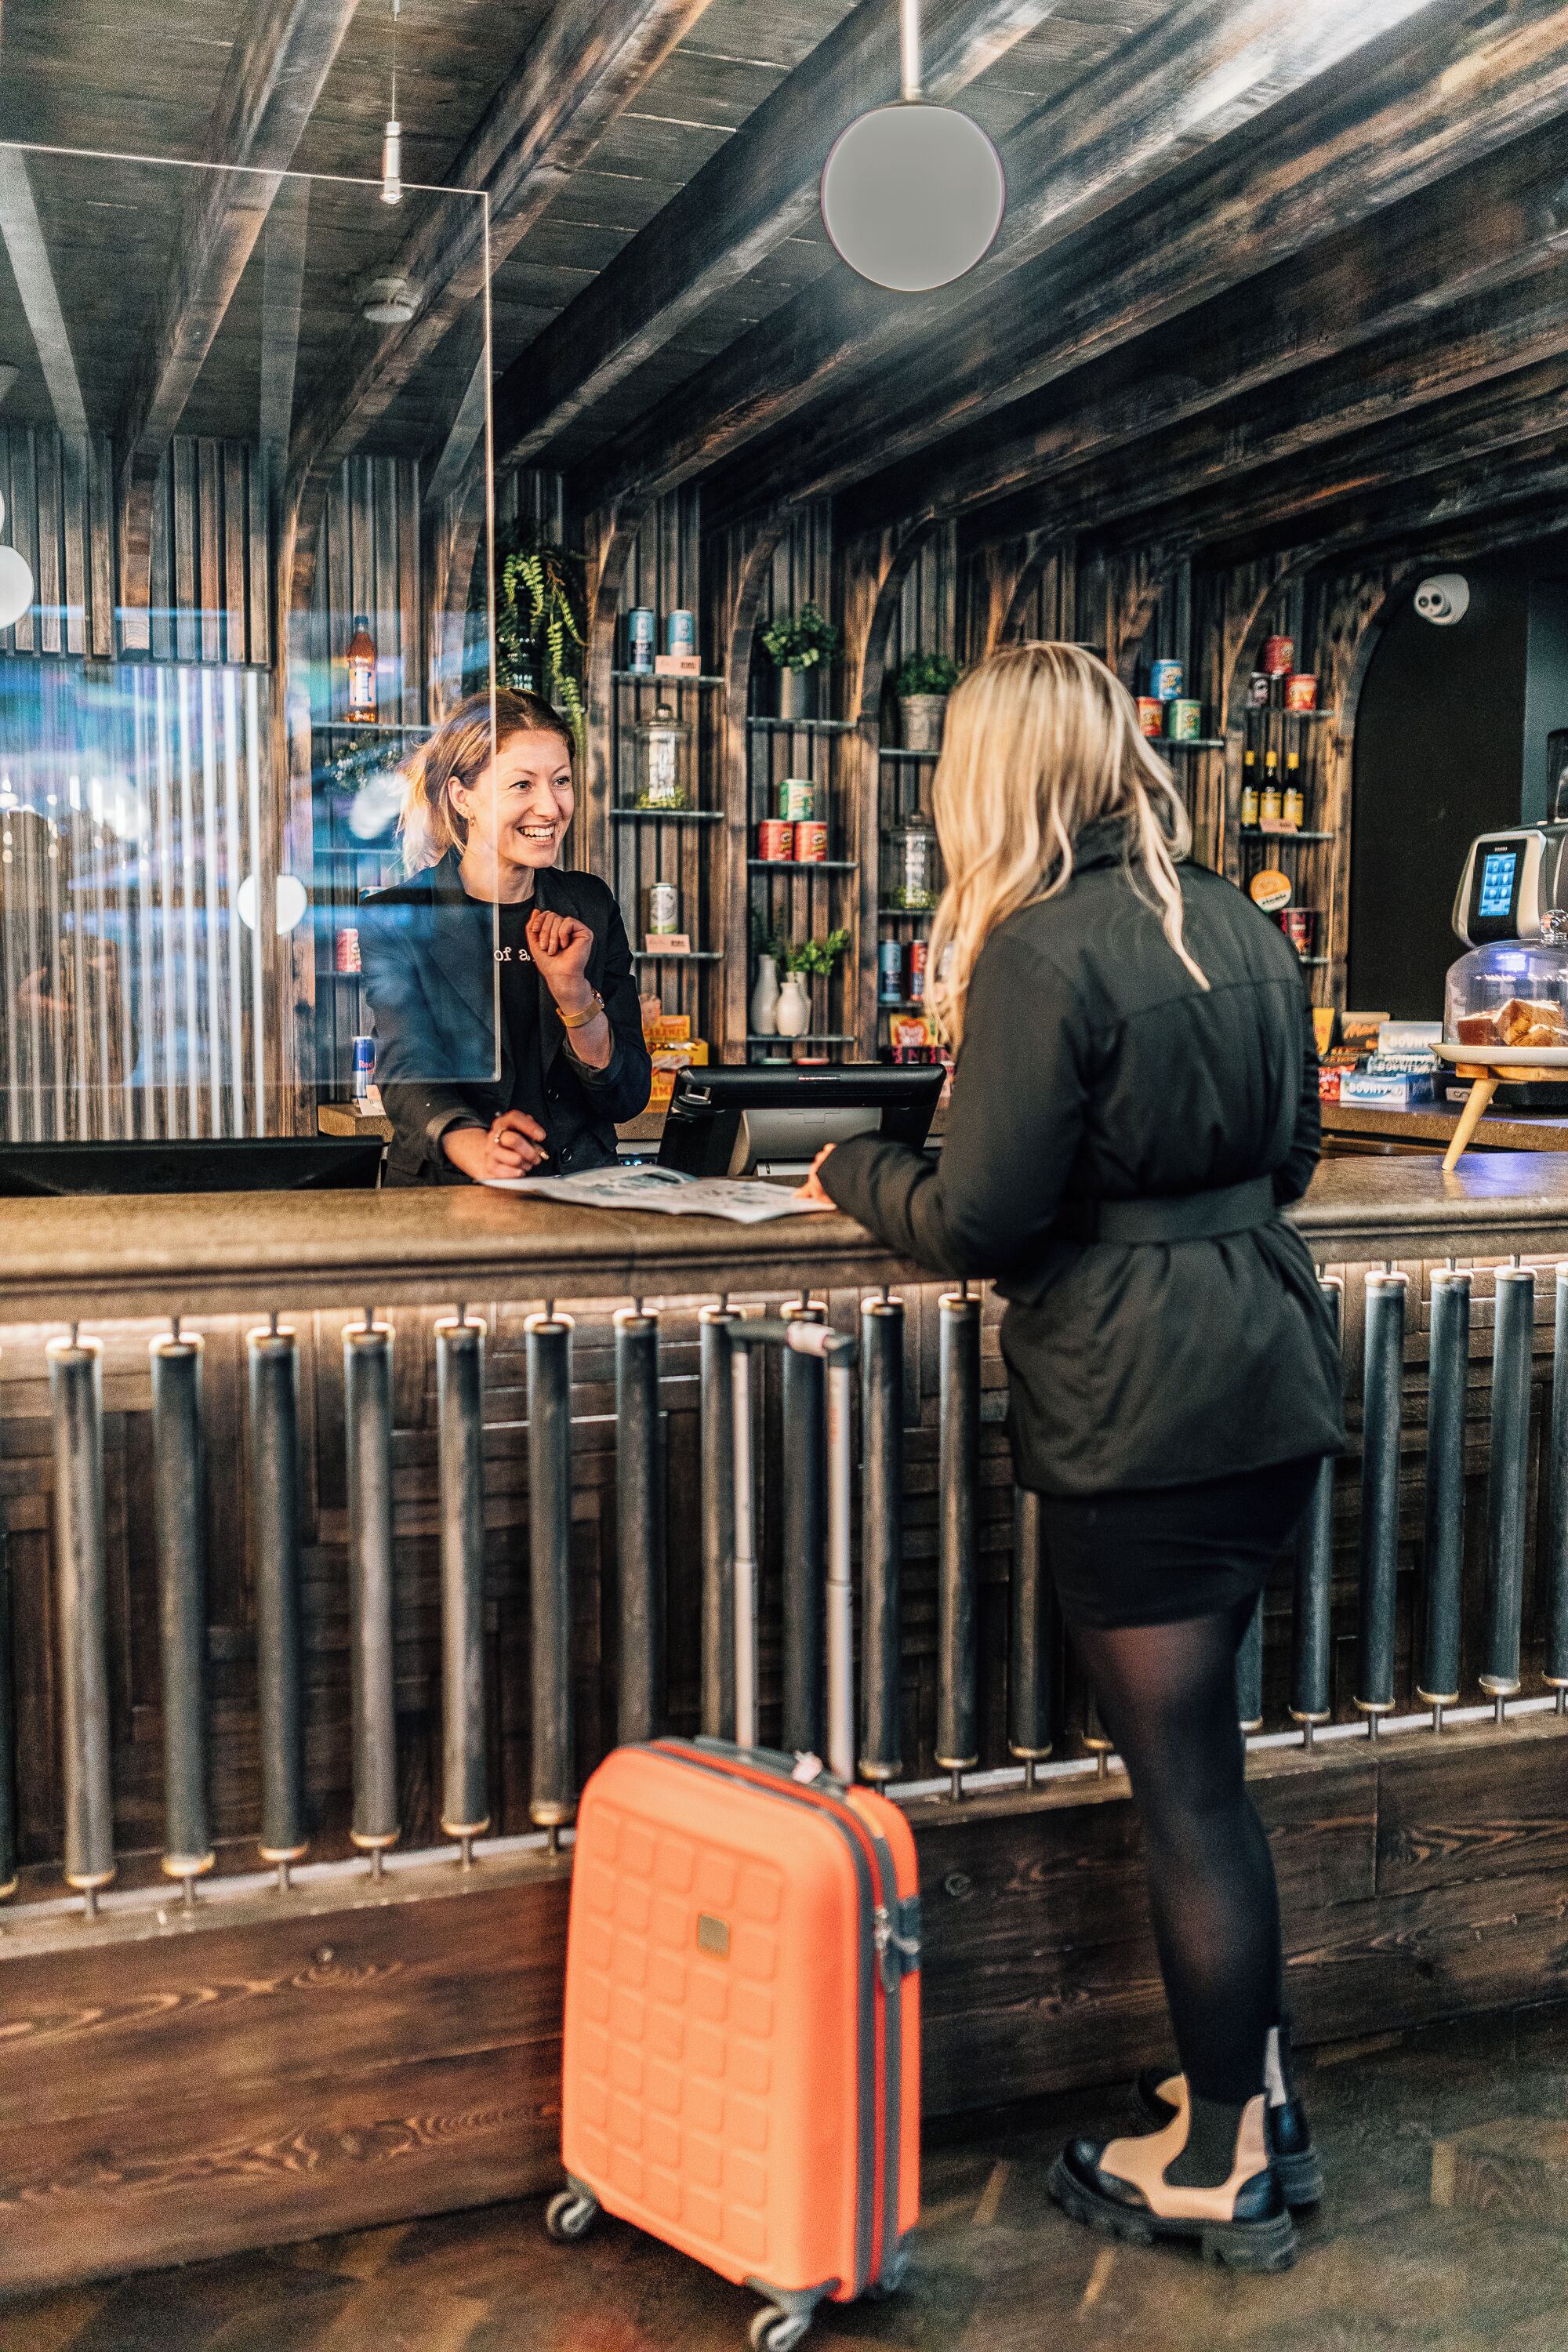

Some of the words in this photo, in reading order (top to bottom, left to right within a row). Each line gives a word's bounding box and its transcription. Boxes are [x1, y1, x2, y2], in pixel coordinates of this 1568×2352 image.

[493, 946, 512, 962] of
[358, 1059, 374, 1069] Red
[1348, 1081, 1388, 1095] BOUNTY
